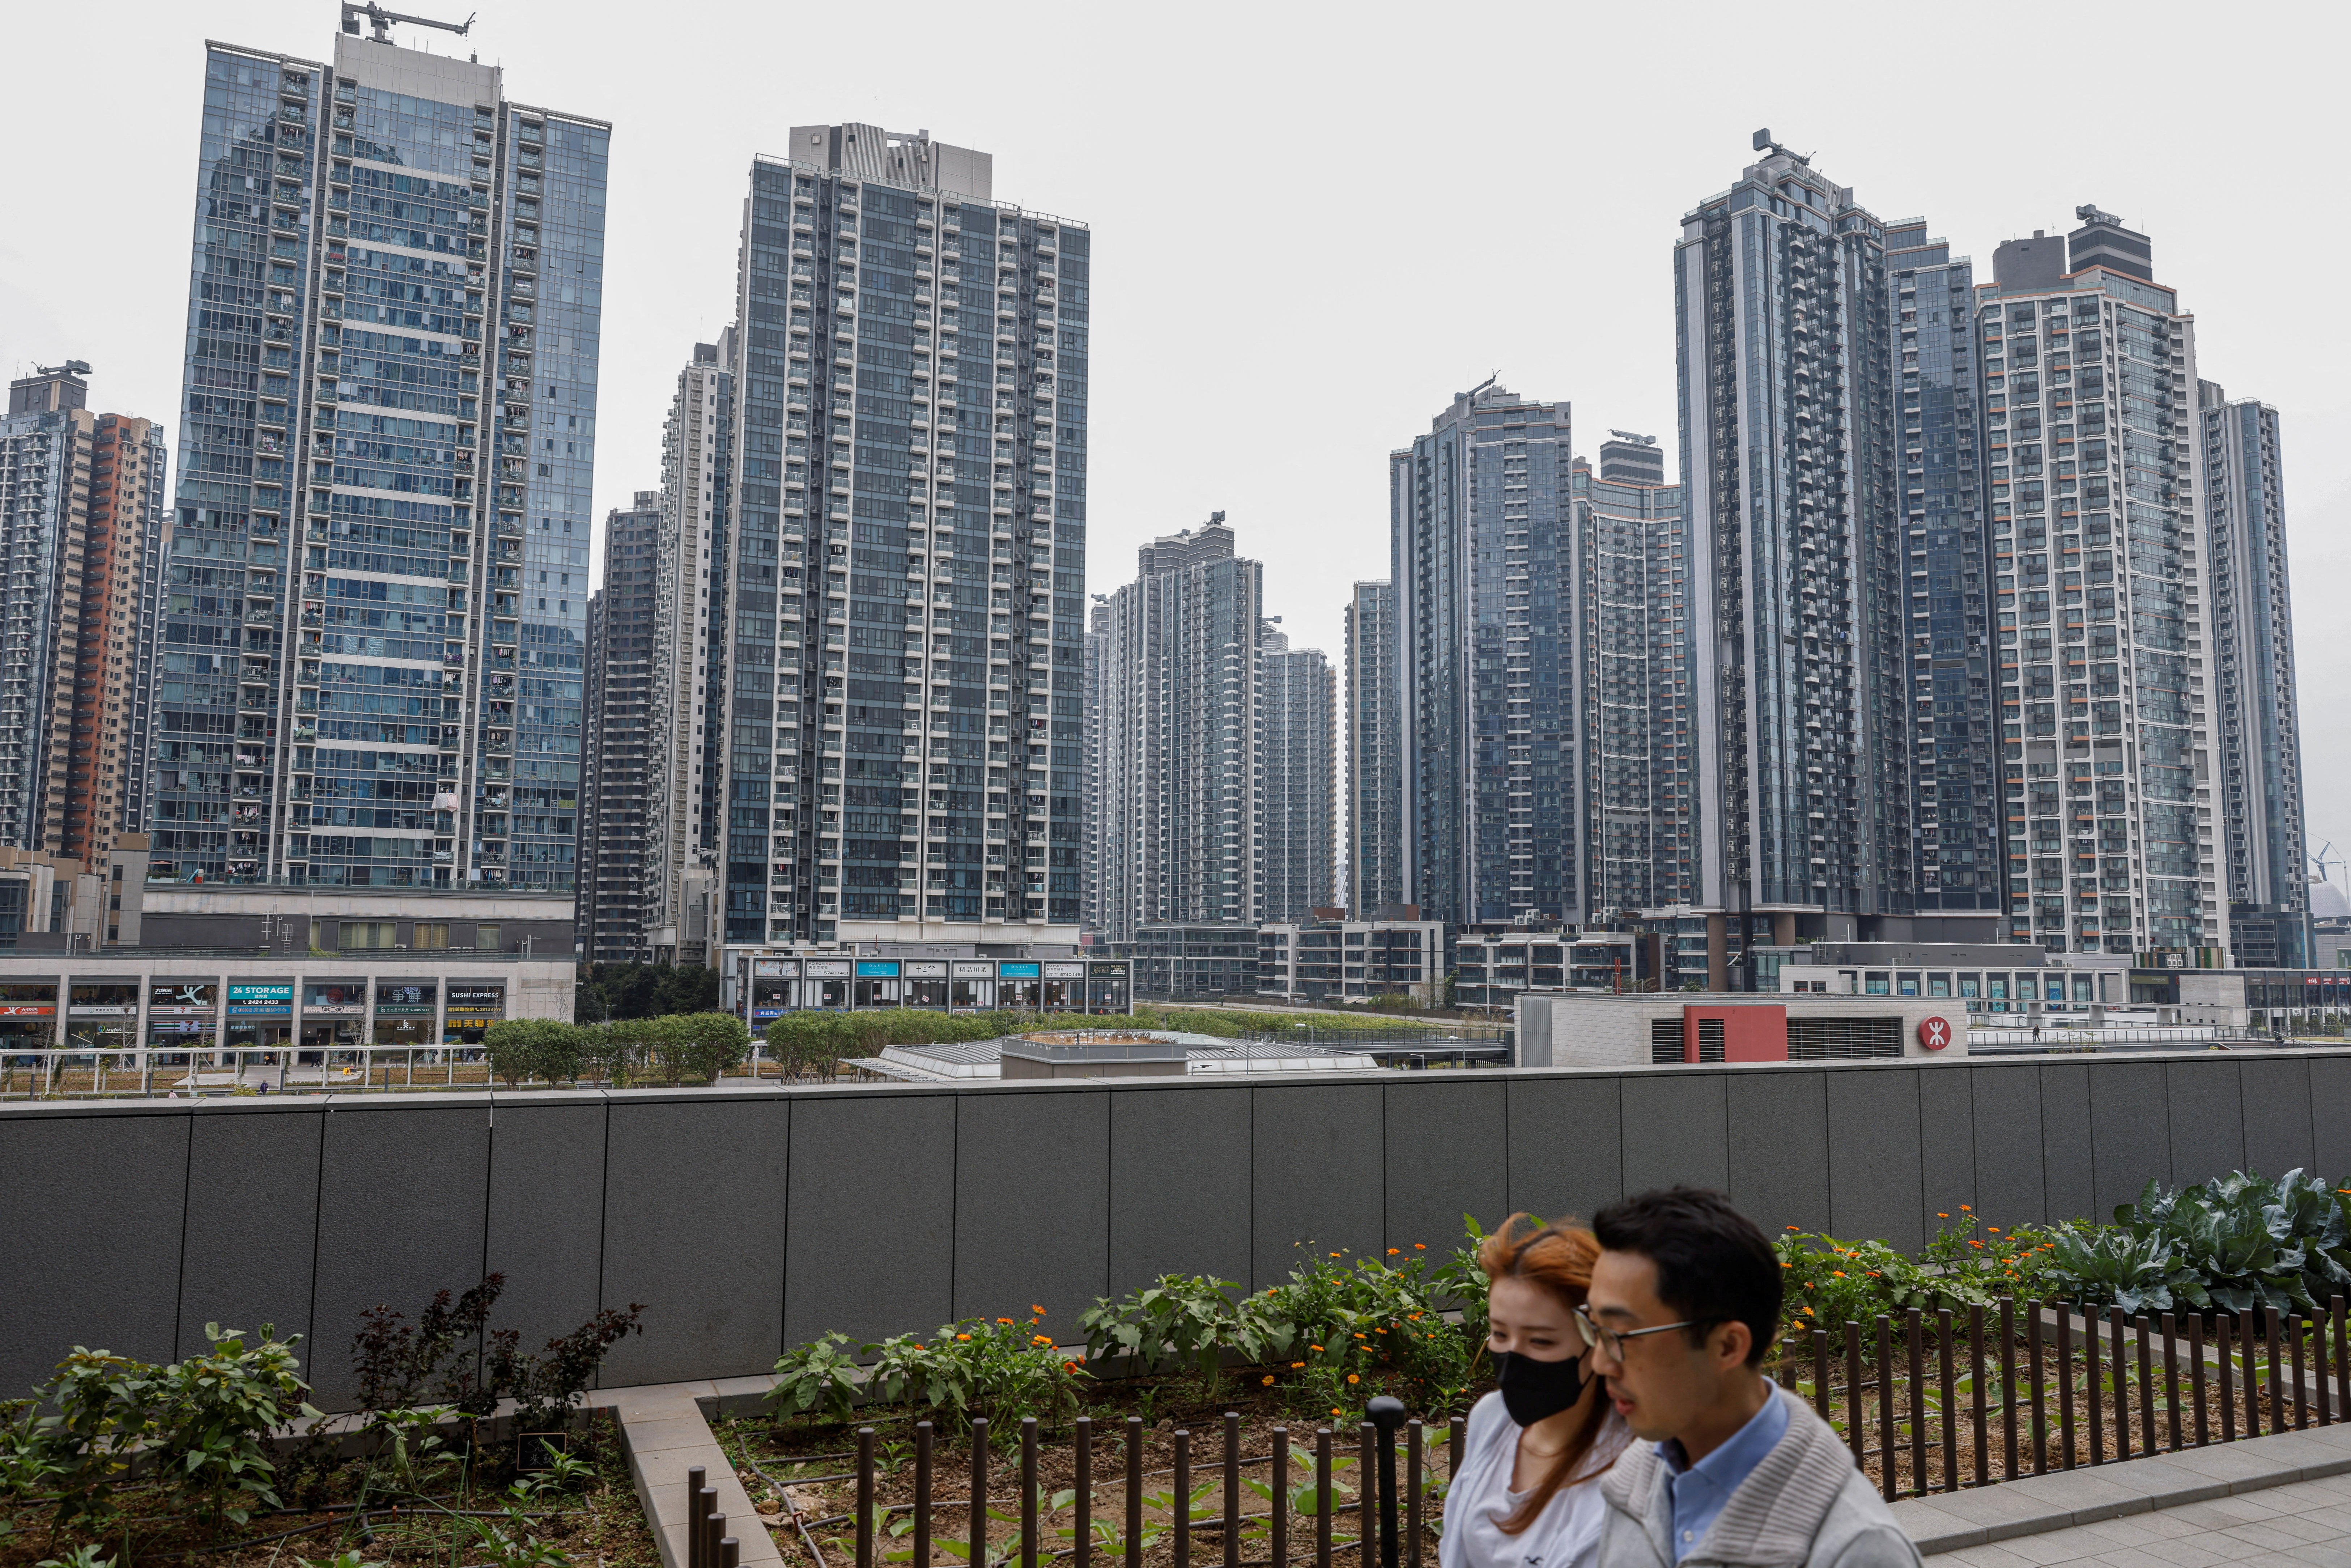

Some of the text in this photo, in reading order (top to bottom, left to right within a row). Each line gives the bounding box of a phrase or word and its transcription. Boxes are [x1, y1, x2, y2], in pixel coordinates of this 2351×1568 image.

[916, 965, 935, 975] 十三少
[392, 990, 421, 1003] 爭鮮
[185, 1021, 194, 1031] 7
[525, 1439, 548, 1453] Shis
